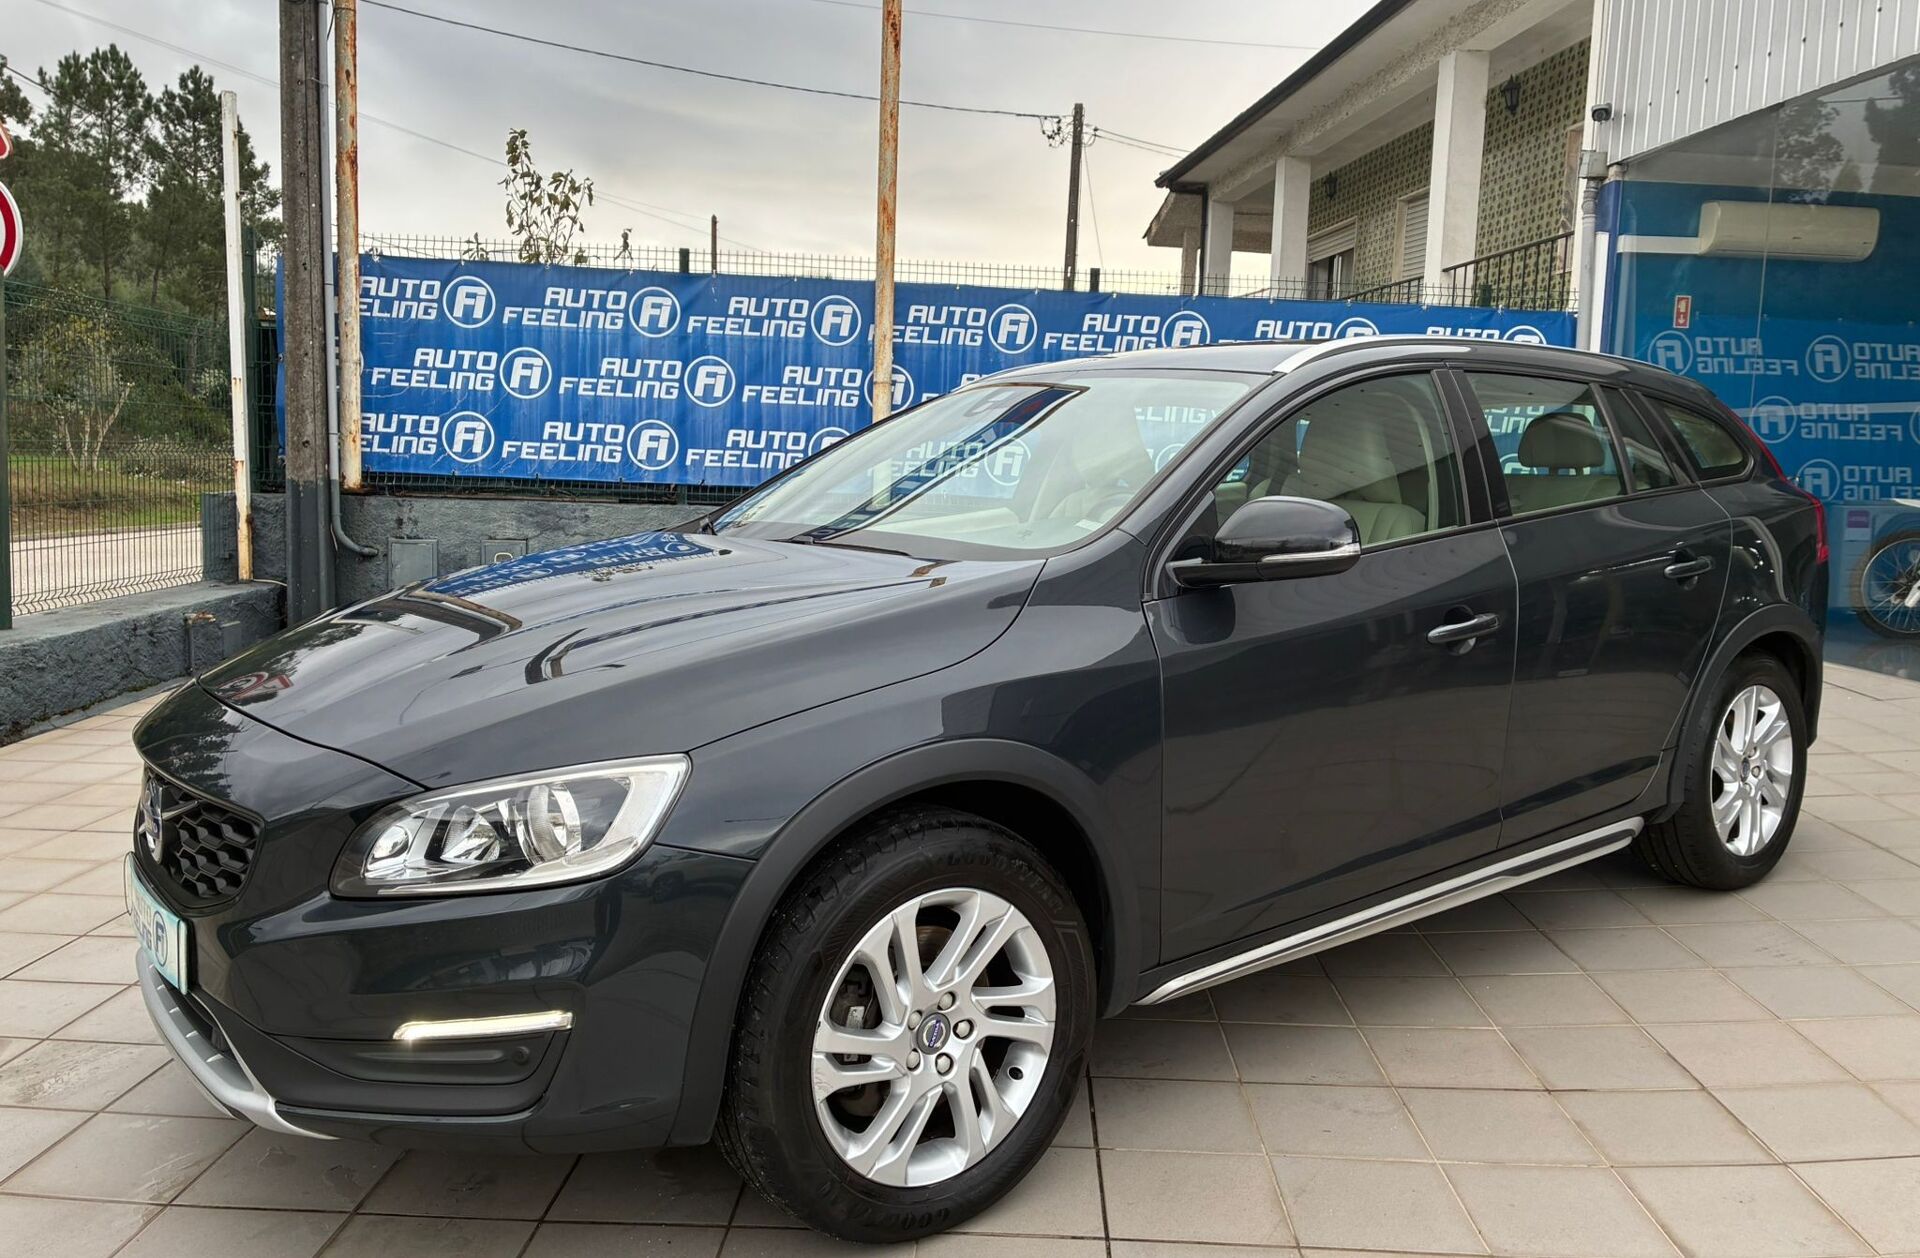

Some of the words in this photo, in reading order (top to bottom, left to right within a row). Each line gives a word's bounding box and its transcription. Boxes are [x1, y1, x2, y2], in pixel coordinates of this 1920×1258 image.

[359, 275, 441, 300] AUTO
[544, 286, 628, 310] AUTO
[359, 297, 438, 320] ELING
[502, 306, 625, 330] FEELING
[728, 296, 810, 318] AUTO
[907, 304, 988, 327] AUTO
[687, 316, 807, 338] FEELING
[1082, 313, 1161, 335] AUTO
[1254, 319, 1333, 340] AUTO
[1042, 332, 1157, 352] FEELING
[413, 347, 499, 371] AUTO
[599, 357, 683, 380] AUTO
[370, 366, 495, 391] FEELING
[558, 376, 680, 400] FEELING
[782, 365, 863, 388] AUTO
[742, 385, 860, 407] FEELING
[360, 412, 440, 435] AUTO
[542, 421, 626, 443] AUTO
[359, 434, 438, 455] ELING
[726, 429, 808, 451] AUTO
[500, 440, 623, 464] FEELING
[684, 448, 806, 470] FEELING
